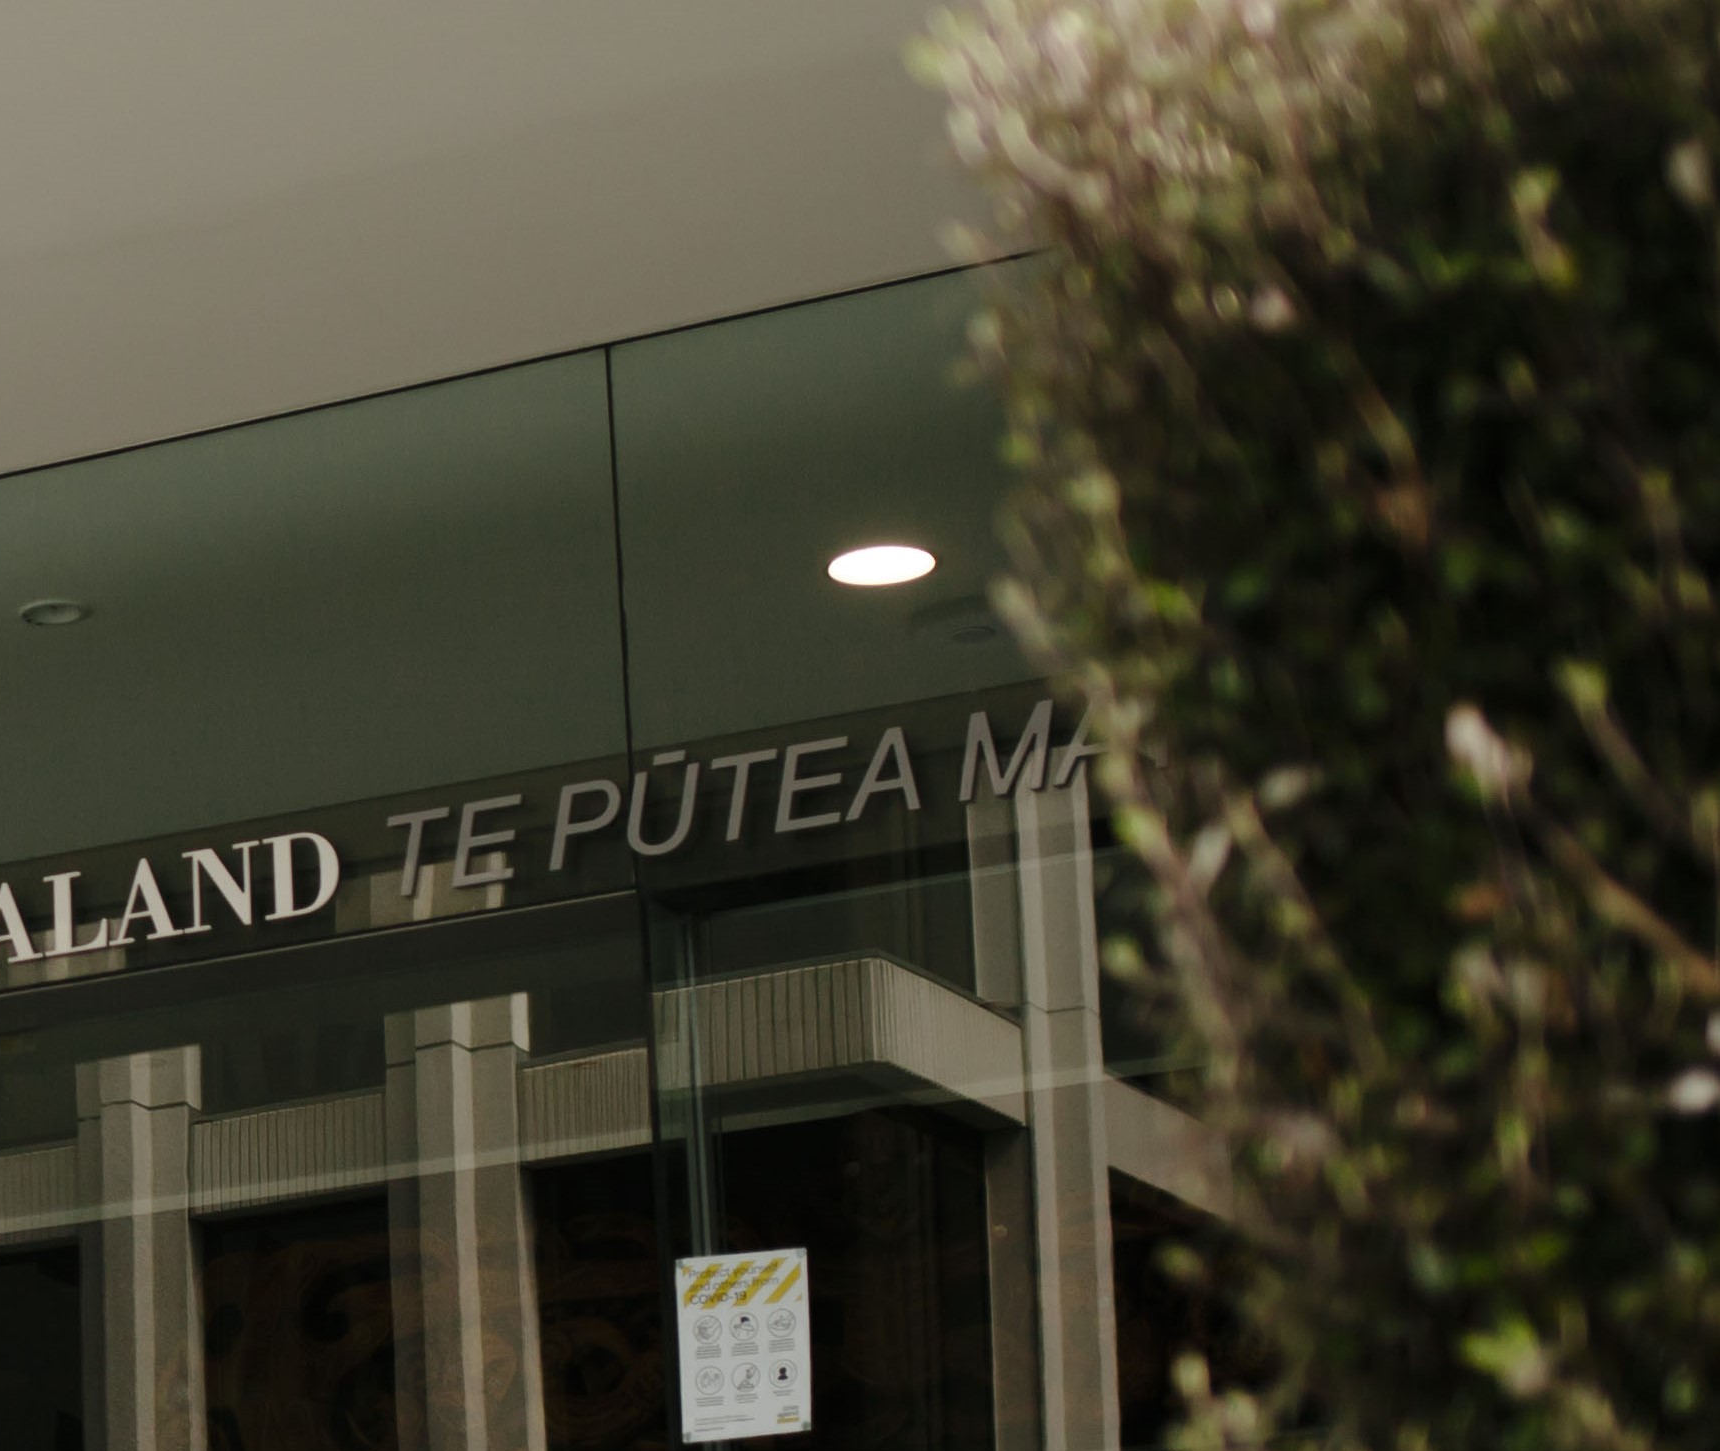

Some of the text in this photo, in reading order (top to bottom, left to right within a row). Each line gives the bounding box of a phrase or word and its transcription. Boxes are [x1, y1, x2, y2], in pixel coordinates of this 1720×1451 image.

[387, 794, 522, 898] TE
[549, 726, 921, 872] PŪTEA
[690, 1291, 747, 1304] COVID-19
